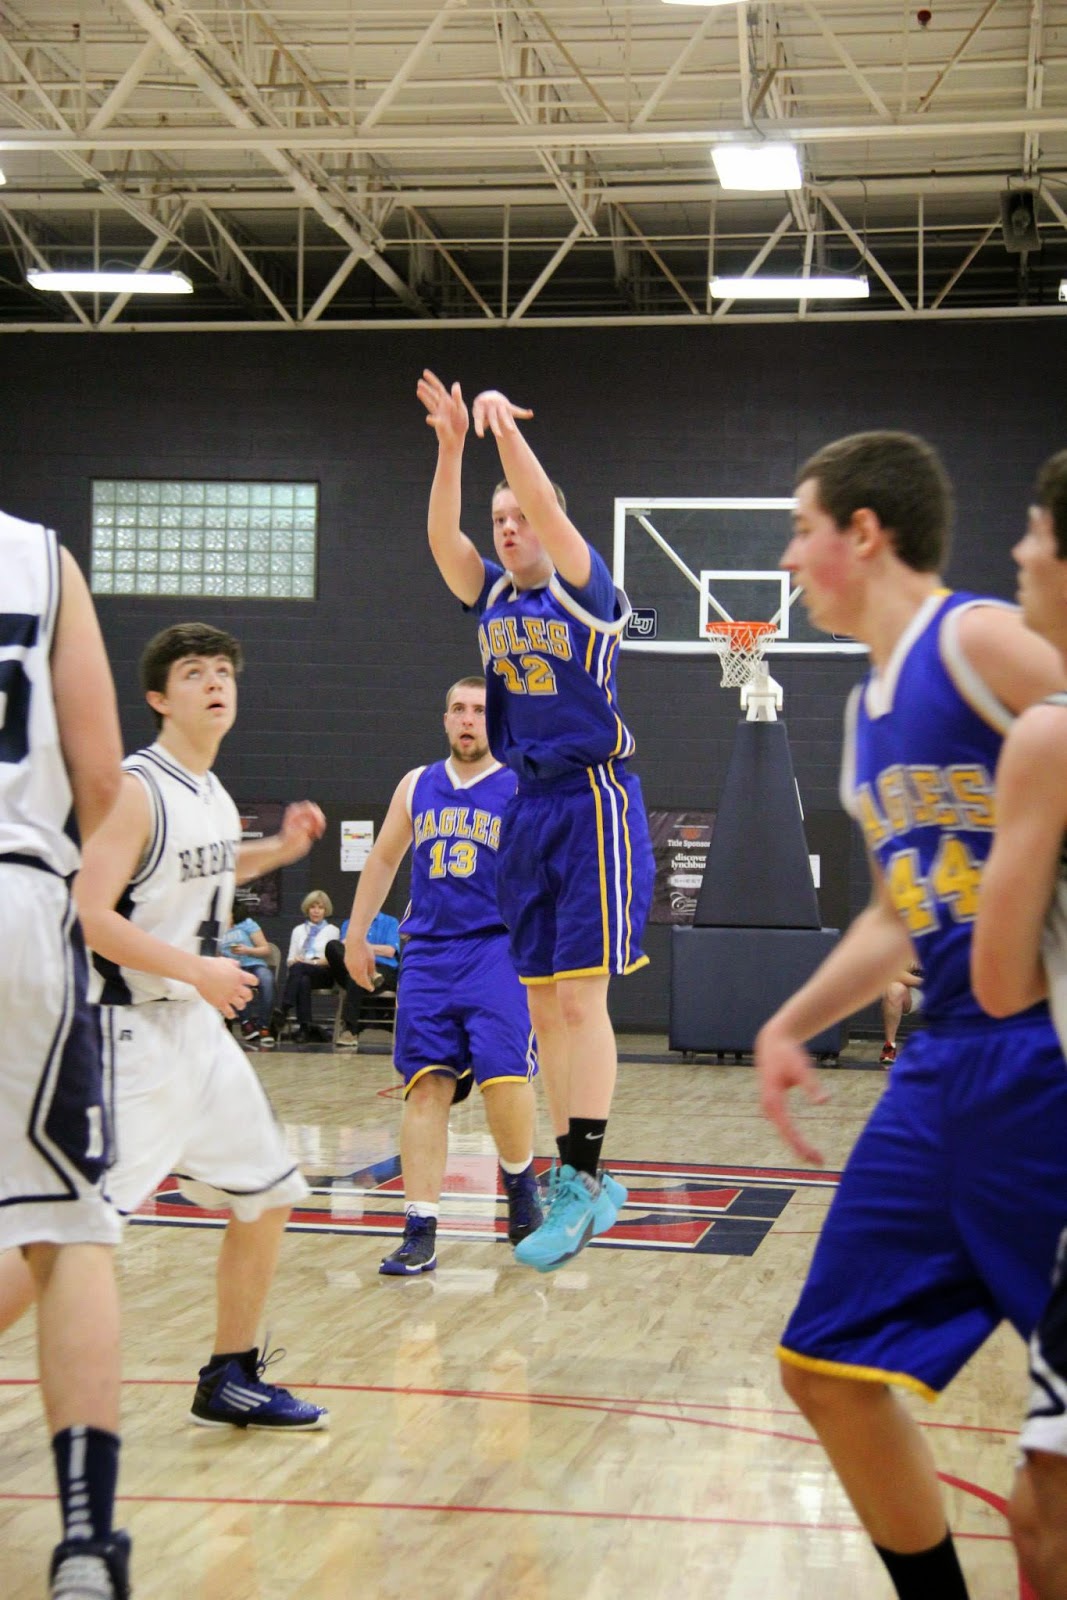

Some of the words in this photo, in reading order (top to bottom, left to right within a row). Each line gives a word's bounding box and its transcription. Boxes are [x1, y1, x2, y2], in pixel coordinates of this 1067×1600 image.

[478, 616, 573, 666] AGLES
[493, 654, 558, 695] 12
[414, 806, 502, 851] EAGLES
[667, 839, 682, 848] Title
[429, 840, 478, 879] 13
[671, 859, 707, 870] lynchbur
[675, 853, 707, 862] discover
[884, 834, 985, 936] 44
